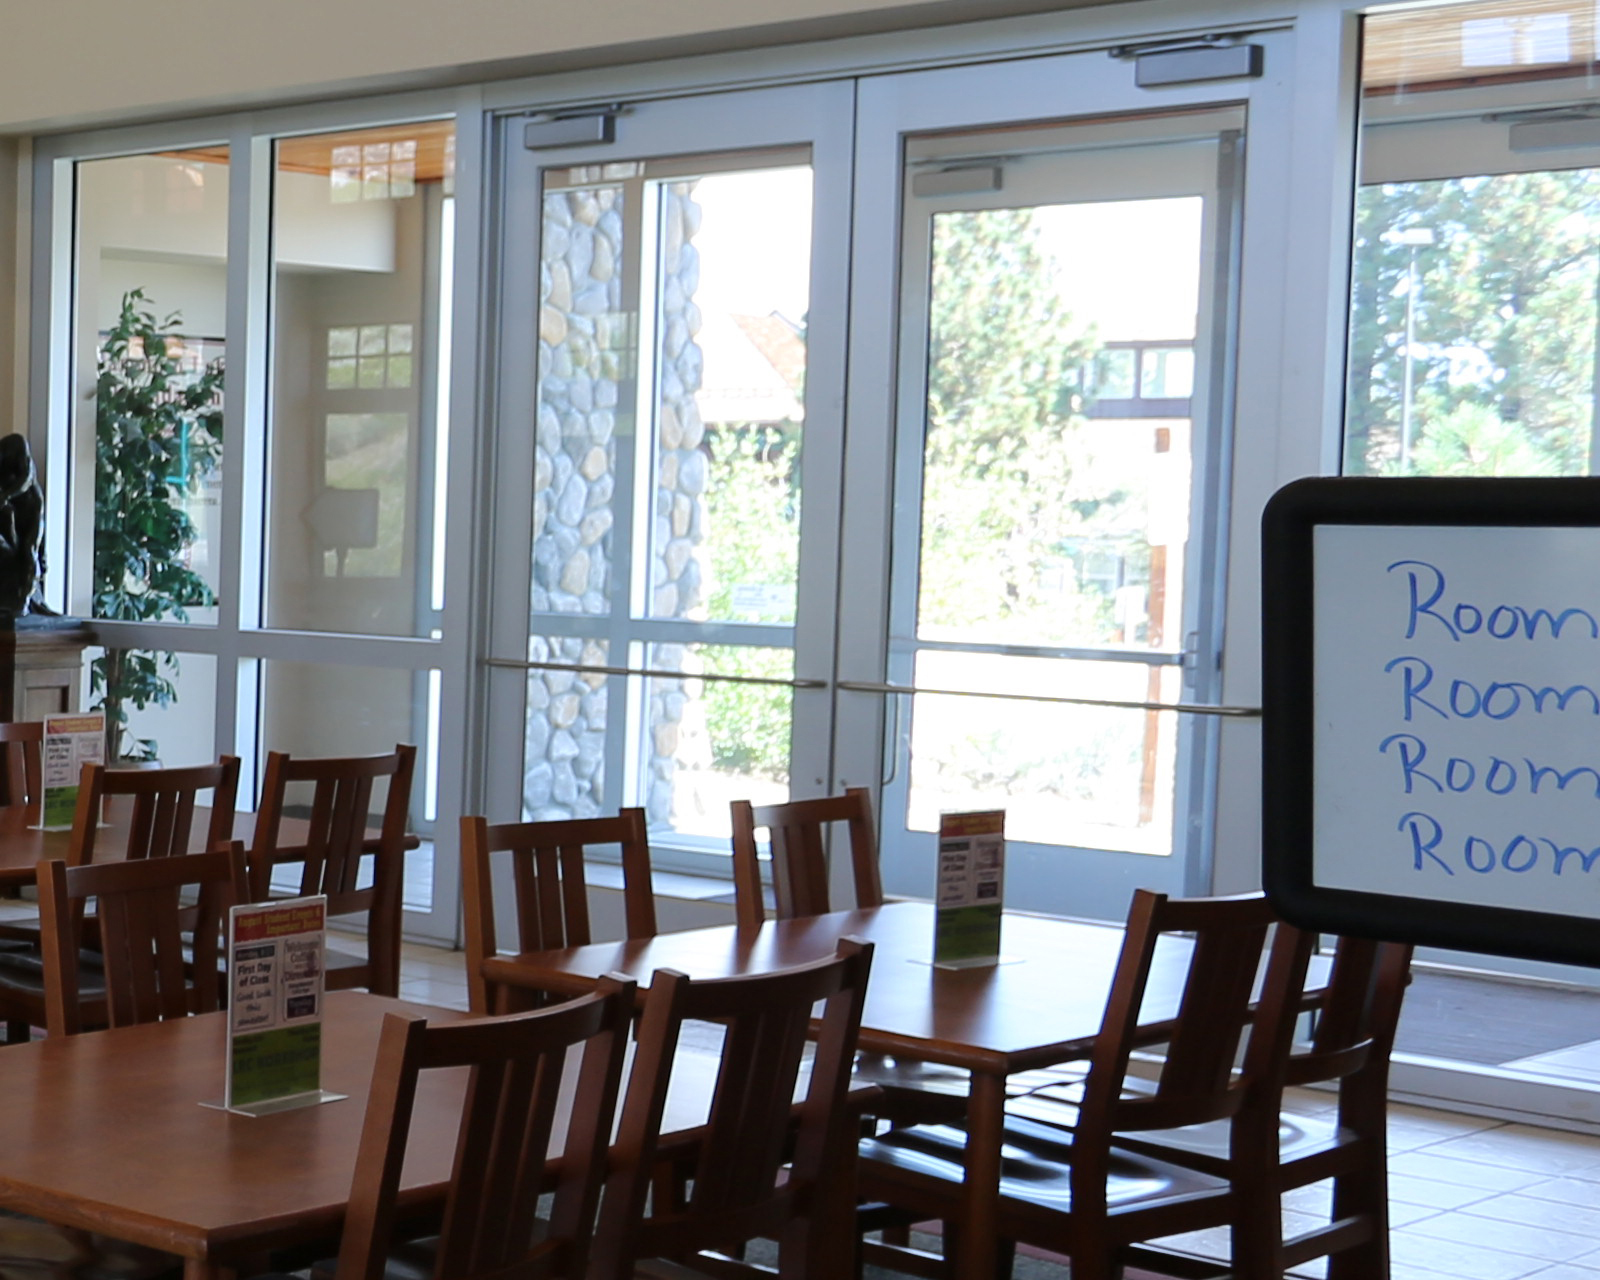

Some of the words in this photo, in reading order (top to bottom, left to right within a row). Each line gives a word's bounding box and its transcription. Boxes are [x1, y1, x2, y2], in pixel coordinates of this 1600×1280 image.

[1387, 560, 1599, 642] Room
[1384, 656, 1600, 722] Room
[1379, 733, 1600, 799] Room
[1398, 812, 1600, 876] Room
[238, 964, 255, 975] First
[257, 962, 271, 973] Day
[239, 977, 248, 987] of
